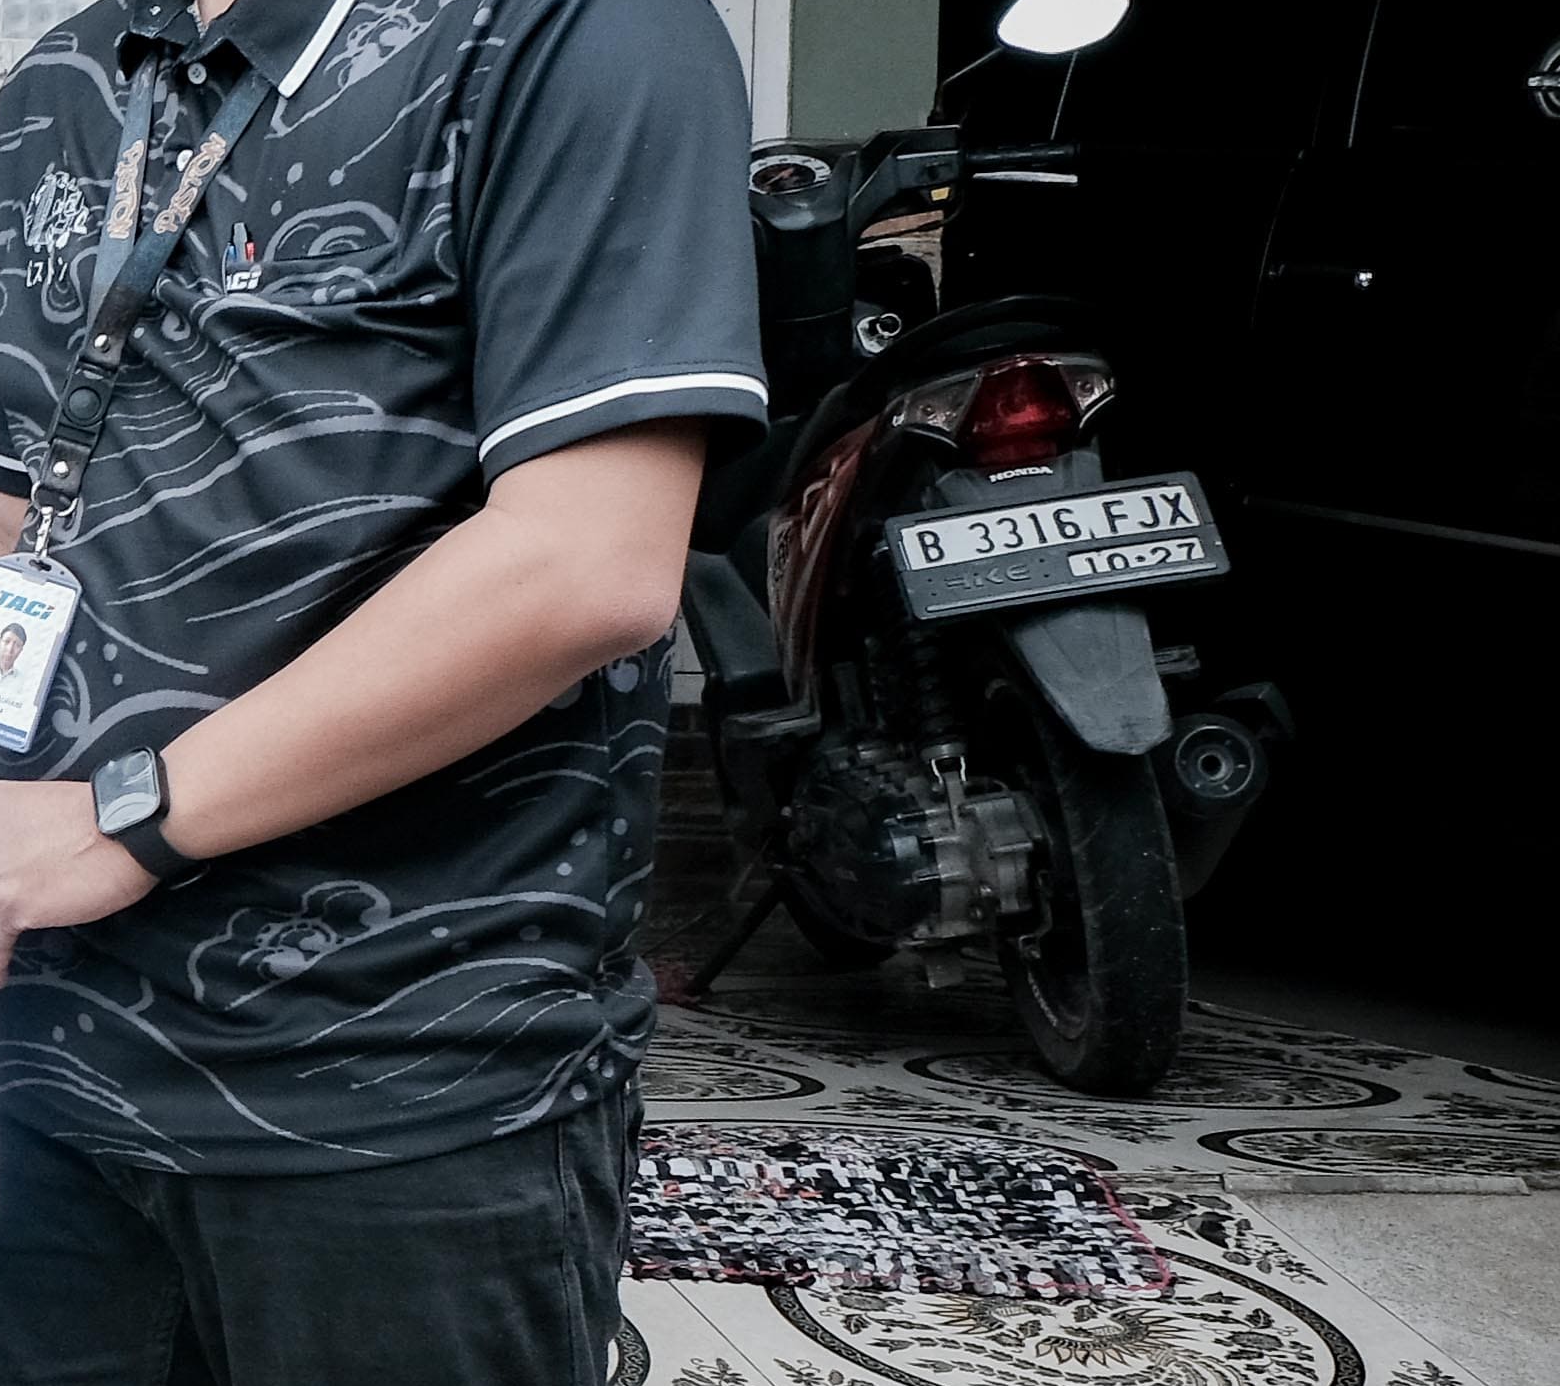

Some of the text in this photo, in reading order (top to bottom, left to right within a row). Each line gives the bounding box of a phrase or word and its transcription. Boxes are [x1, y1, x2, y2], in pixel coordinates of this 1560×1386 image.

[988, 465, 1054, 484] HONDA
[915, 491, 1193, 565] B 3316 FJX
